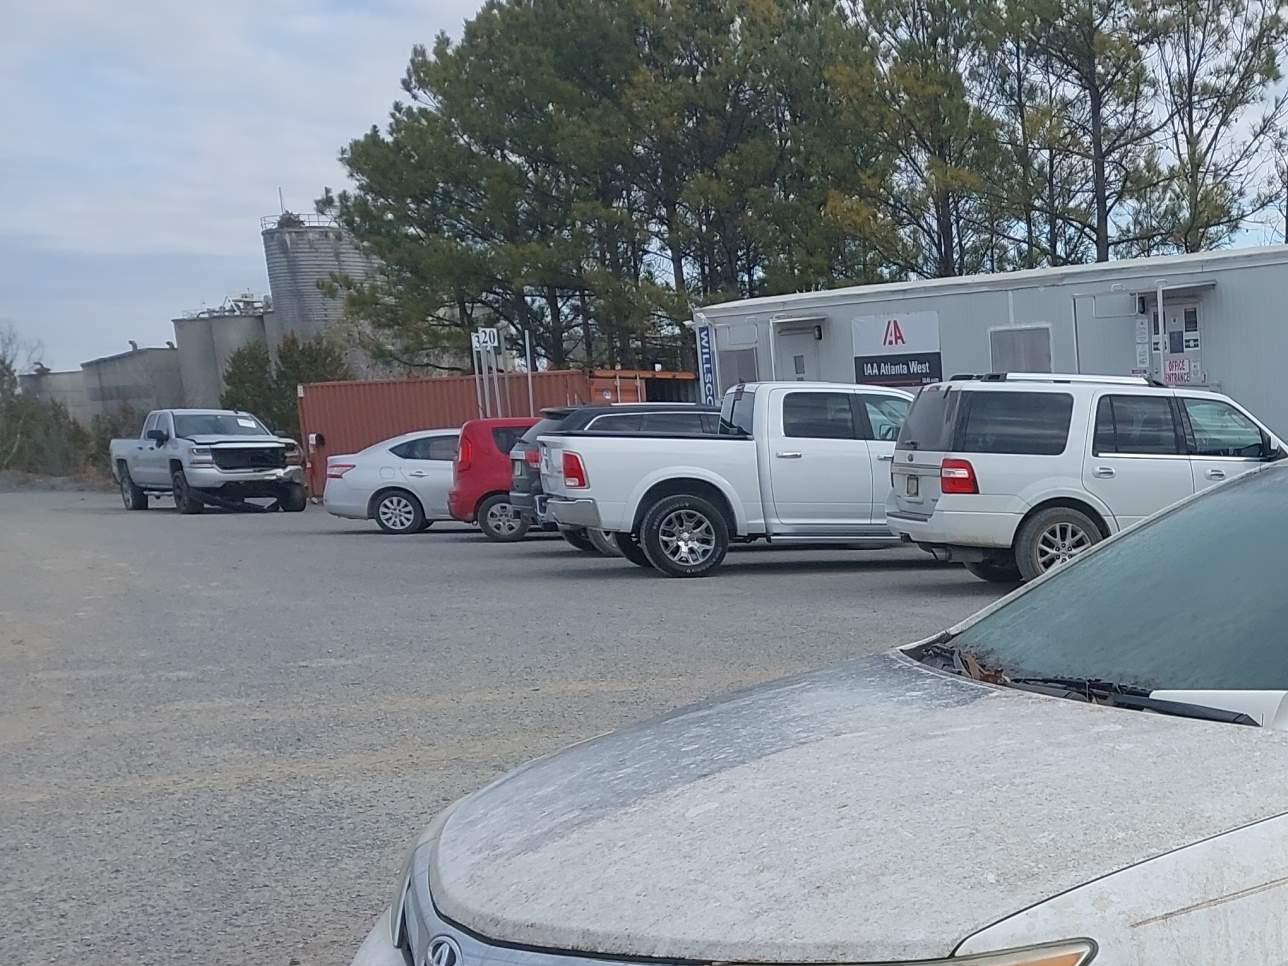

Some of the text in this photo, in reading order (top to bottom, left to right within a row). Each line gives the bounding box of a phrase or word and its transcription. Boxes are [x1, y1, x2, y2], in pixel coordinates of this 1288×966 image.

[481, 330, 496, 345] 20
[863, 361, 930, 377] IAA Atlanta West
[1168, 359, 1185, 372] OFFICE
